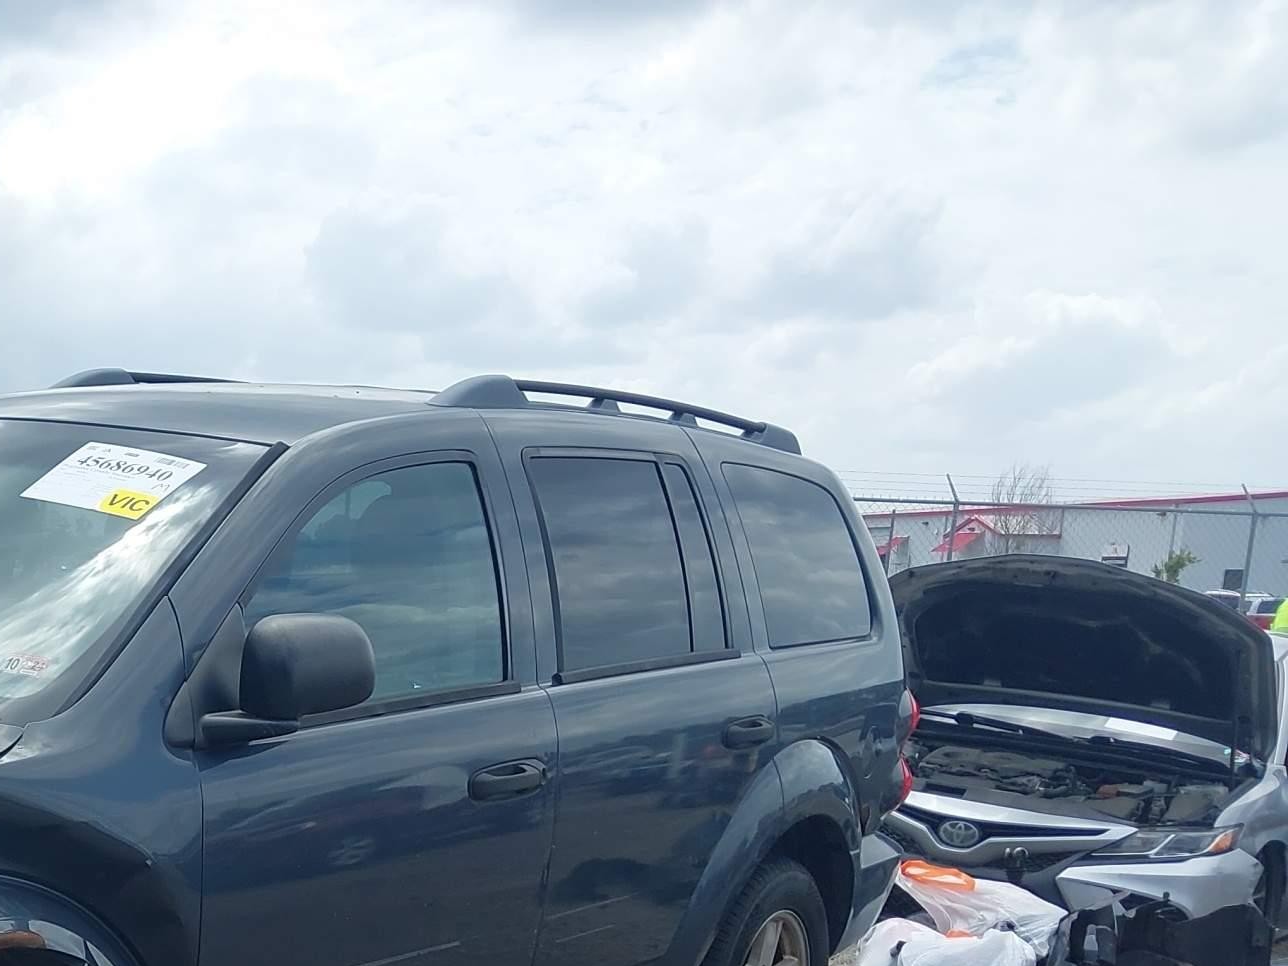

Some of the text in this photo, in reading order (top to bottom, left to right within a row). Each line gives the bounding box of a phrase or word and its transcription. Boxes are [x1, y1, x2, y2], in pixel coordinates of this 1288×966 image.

[77, 456, 174, 481] 45686940
[108, 493, 150, 512] VIC
[4, 656, 21, 671] 10
